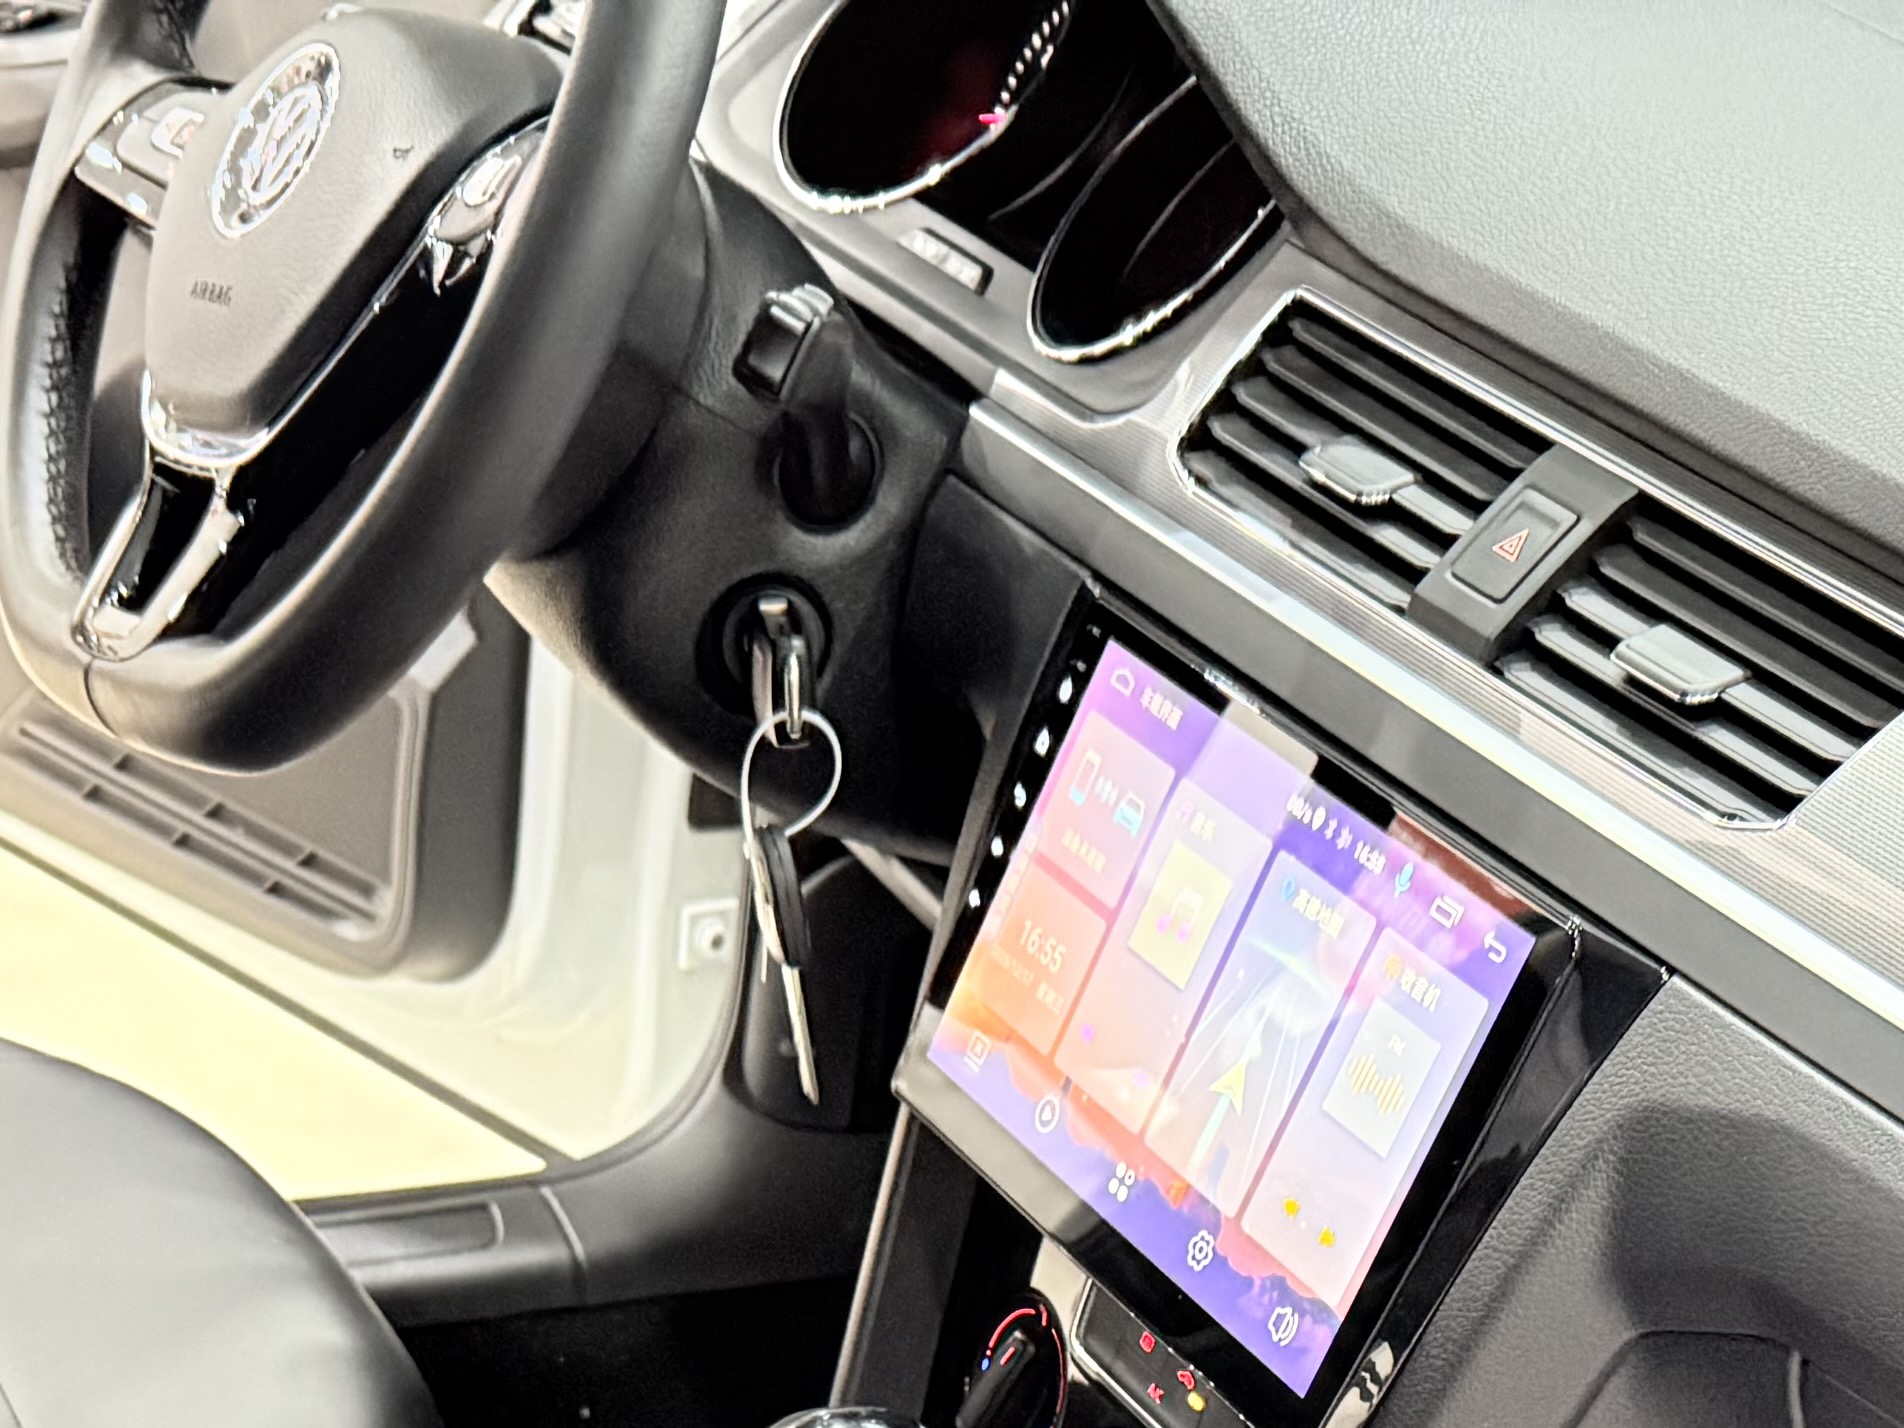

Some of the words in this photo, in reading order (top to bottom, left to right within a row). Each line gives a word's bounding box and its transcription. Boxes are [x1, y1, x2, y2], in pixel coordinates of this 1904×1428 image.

[190, 279, 233, 307] AIRBAG
[1293, 888, 1346, 940] 高德地图
[1020, 919, 1067, 974] 16:55
[1399, 967, 1442, 1014] 收音机
